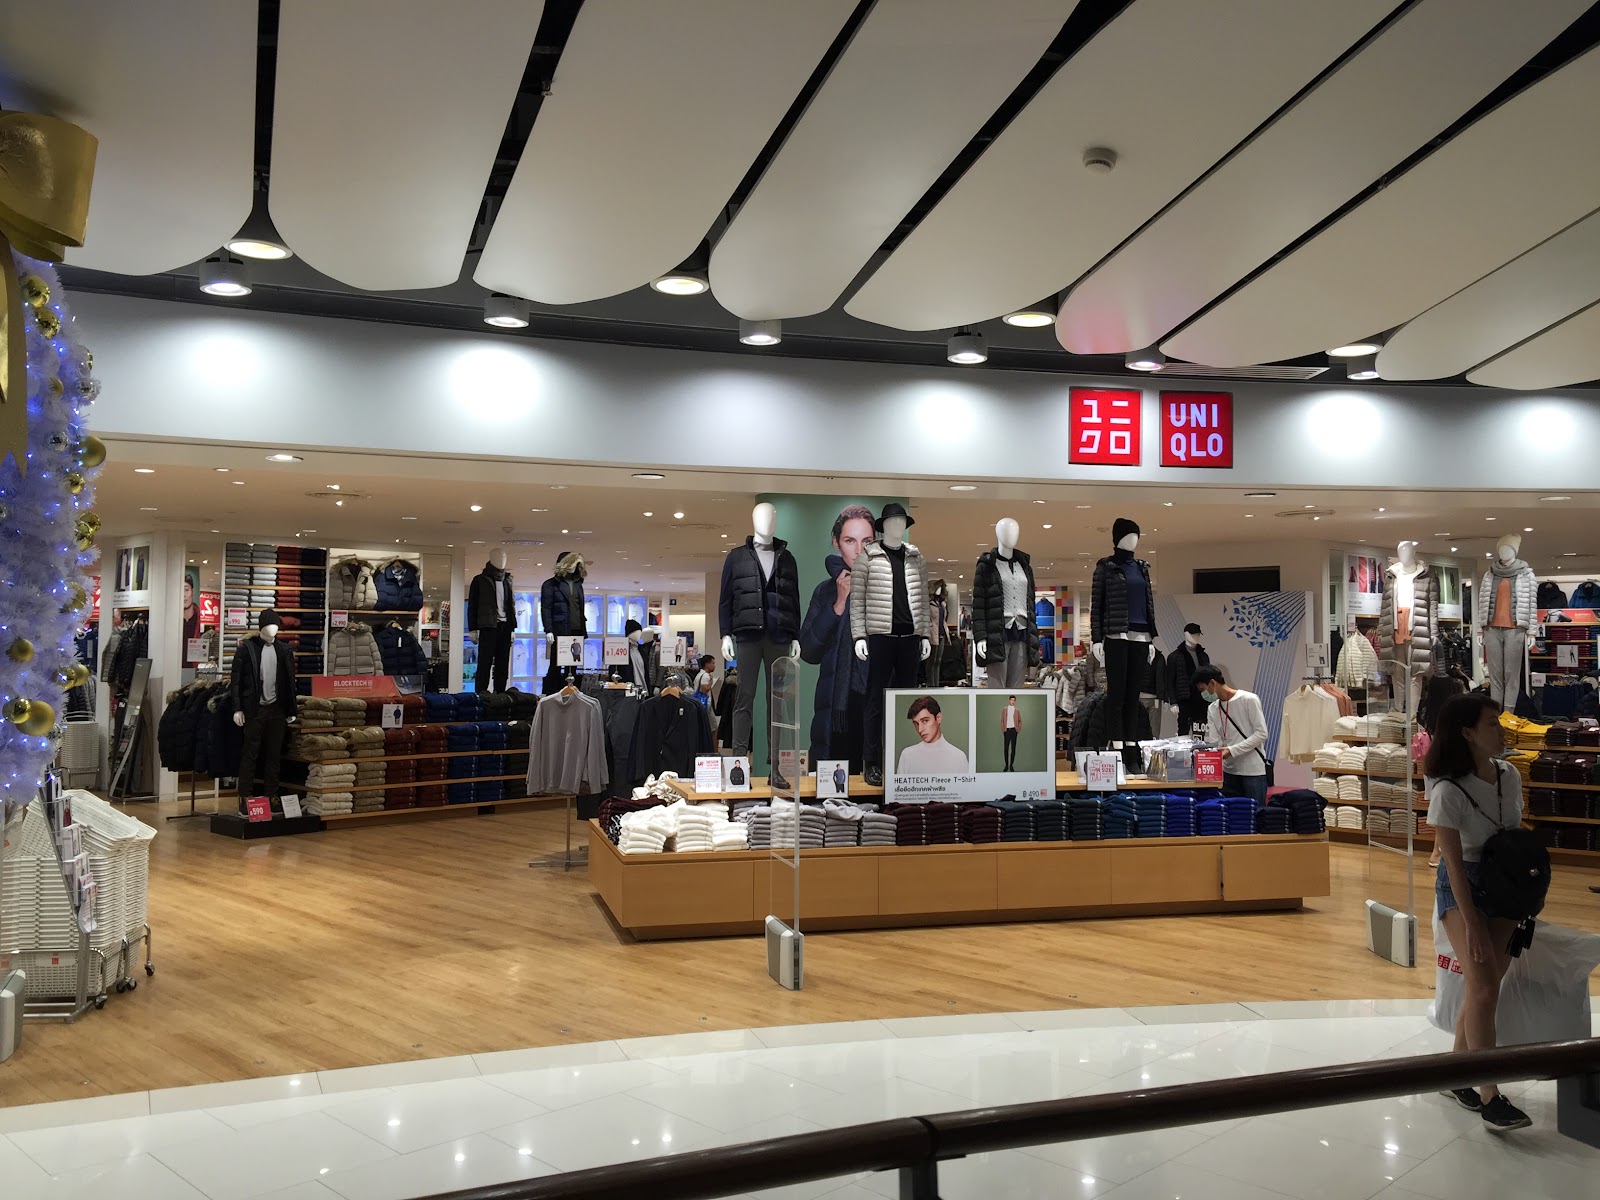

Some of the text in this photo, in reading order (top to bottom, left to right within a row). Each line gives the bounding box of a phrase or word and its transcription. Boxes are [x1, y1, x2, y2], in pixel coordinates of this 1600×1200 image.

[1081, 399, 1131, 424] ユニ
[1169, 403, 1218, 428] UNI
[1079, 429, 1131, 455] クロ
[1170, 432, 1224, 461] QLO
[894, 776, 929, 784] HEATTECH
[931, 776, 951, 784] Fleece
